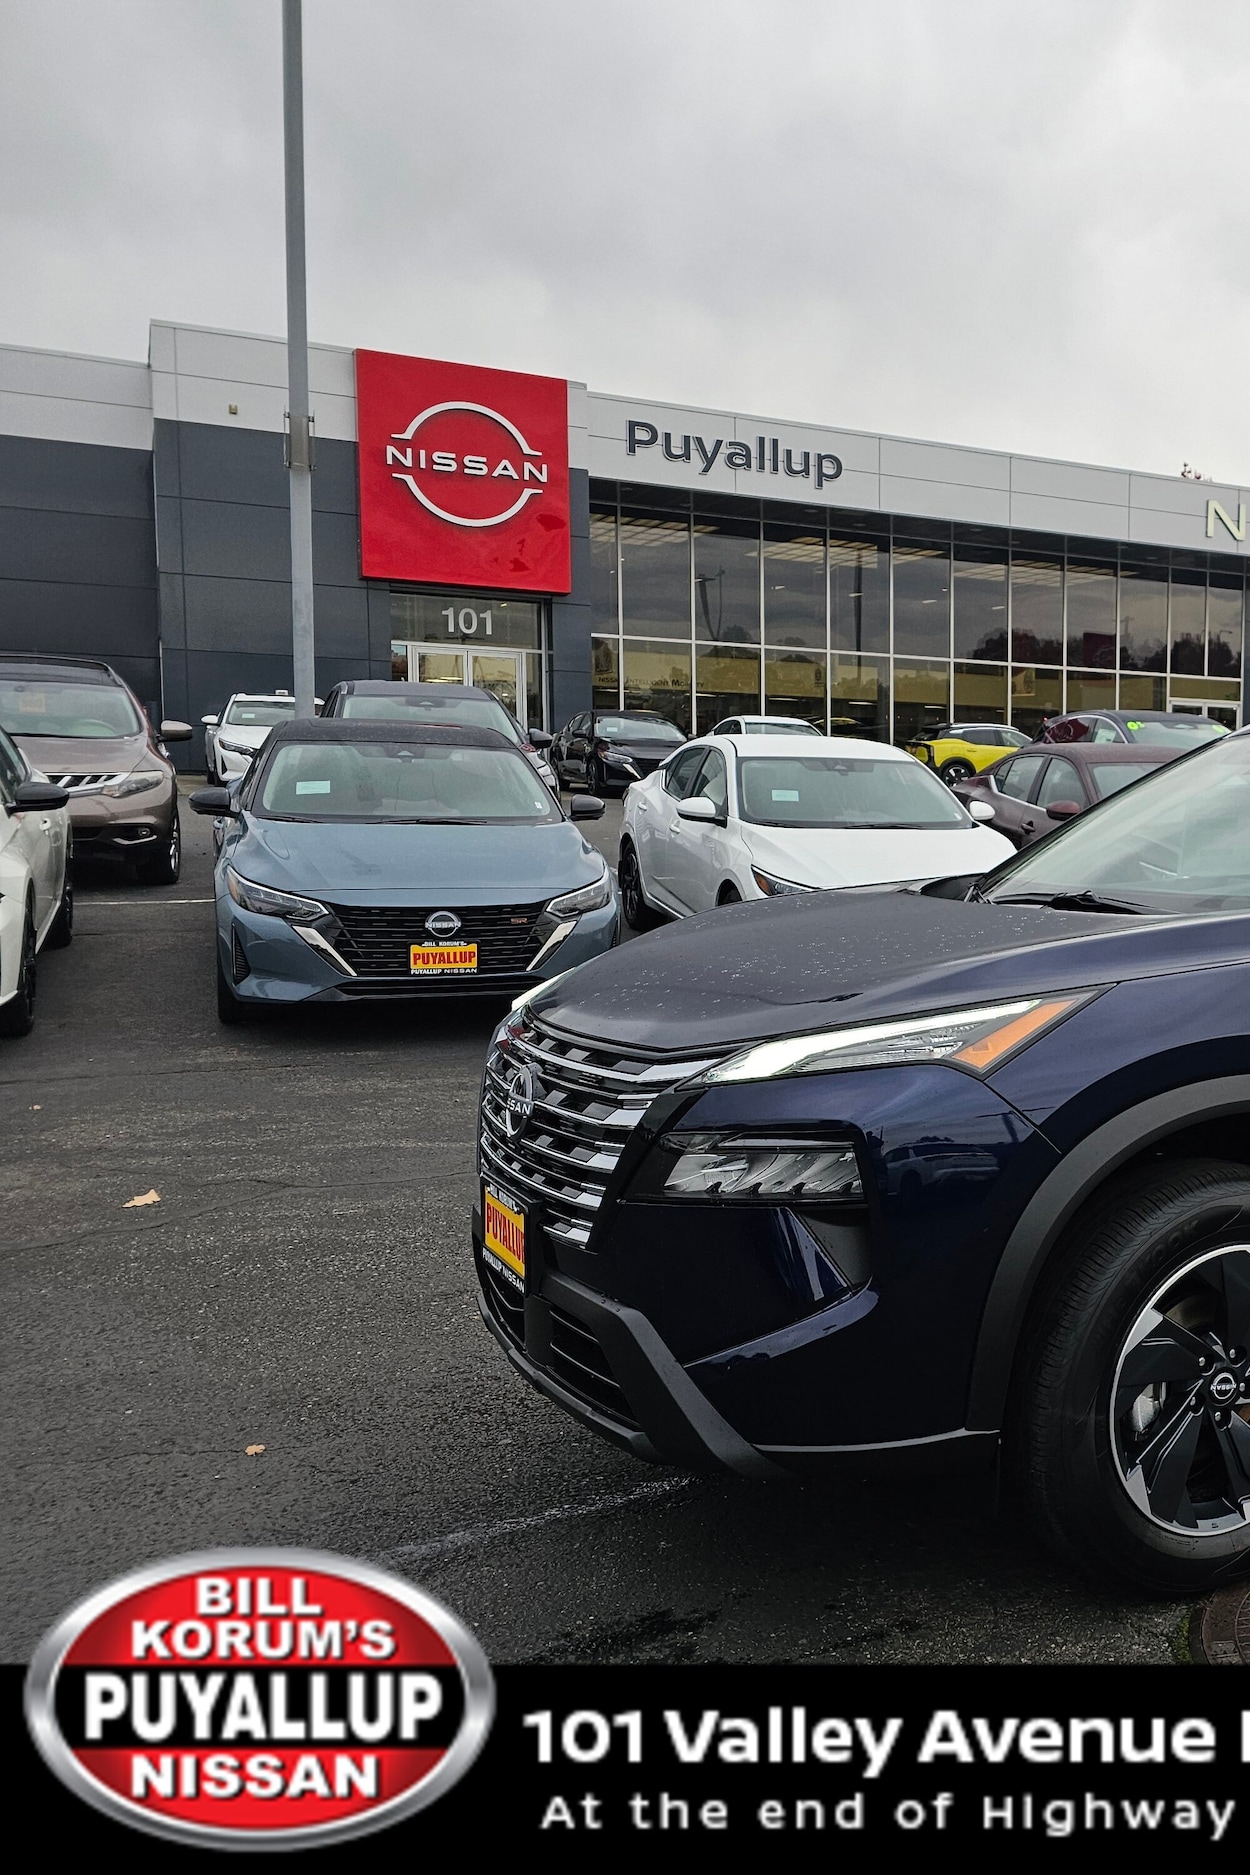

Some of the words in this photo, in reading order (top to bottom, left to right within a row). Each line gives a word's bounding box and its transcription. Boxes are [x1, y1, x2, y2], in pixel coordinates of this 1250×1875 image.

[386, 445, 548, 483] NISSAN
[625, 419, 844, 490] Puyallup
[441, 606, 493, 635] 101
[413, 951, 476, 966] PUYALLUP
[502, 1265, 525, 1294] NISSAN
